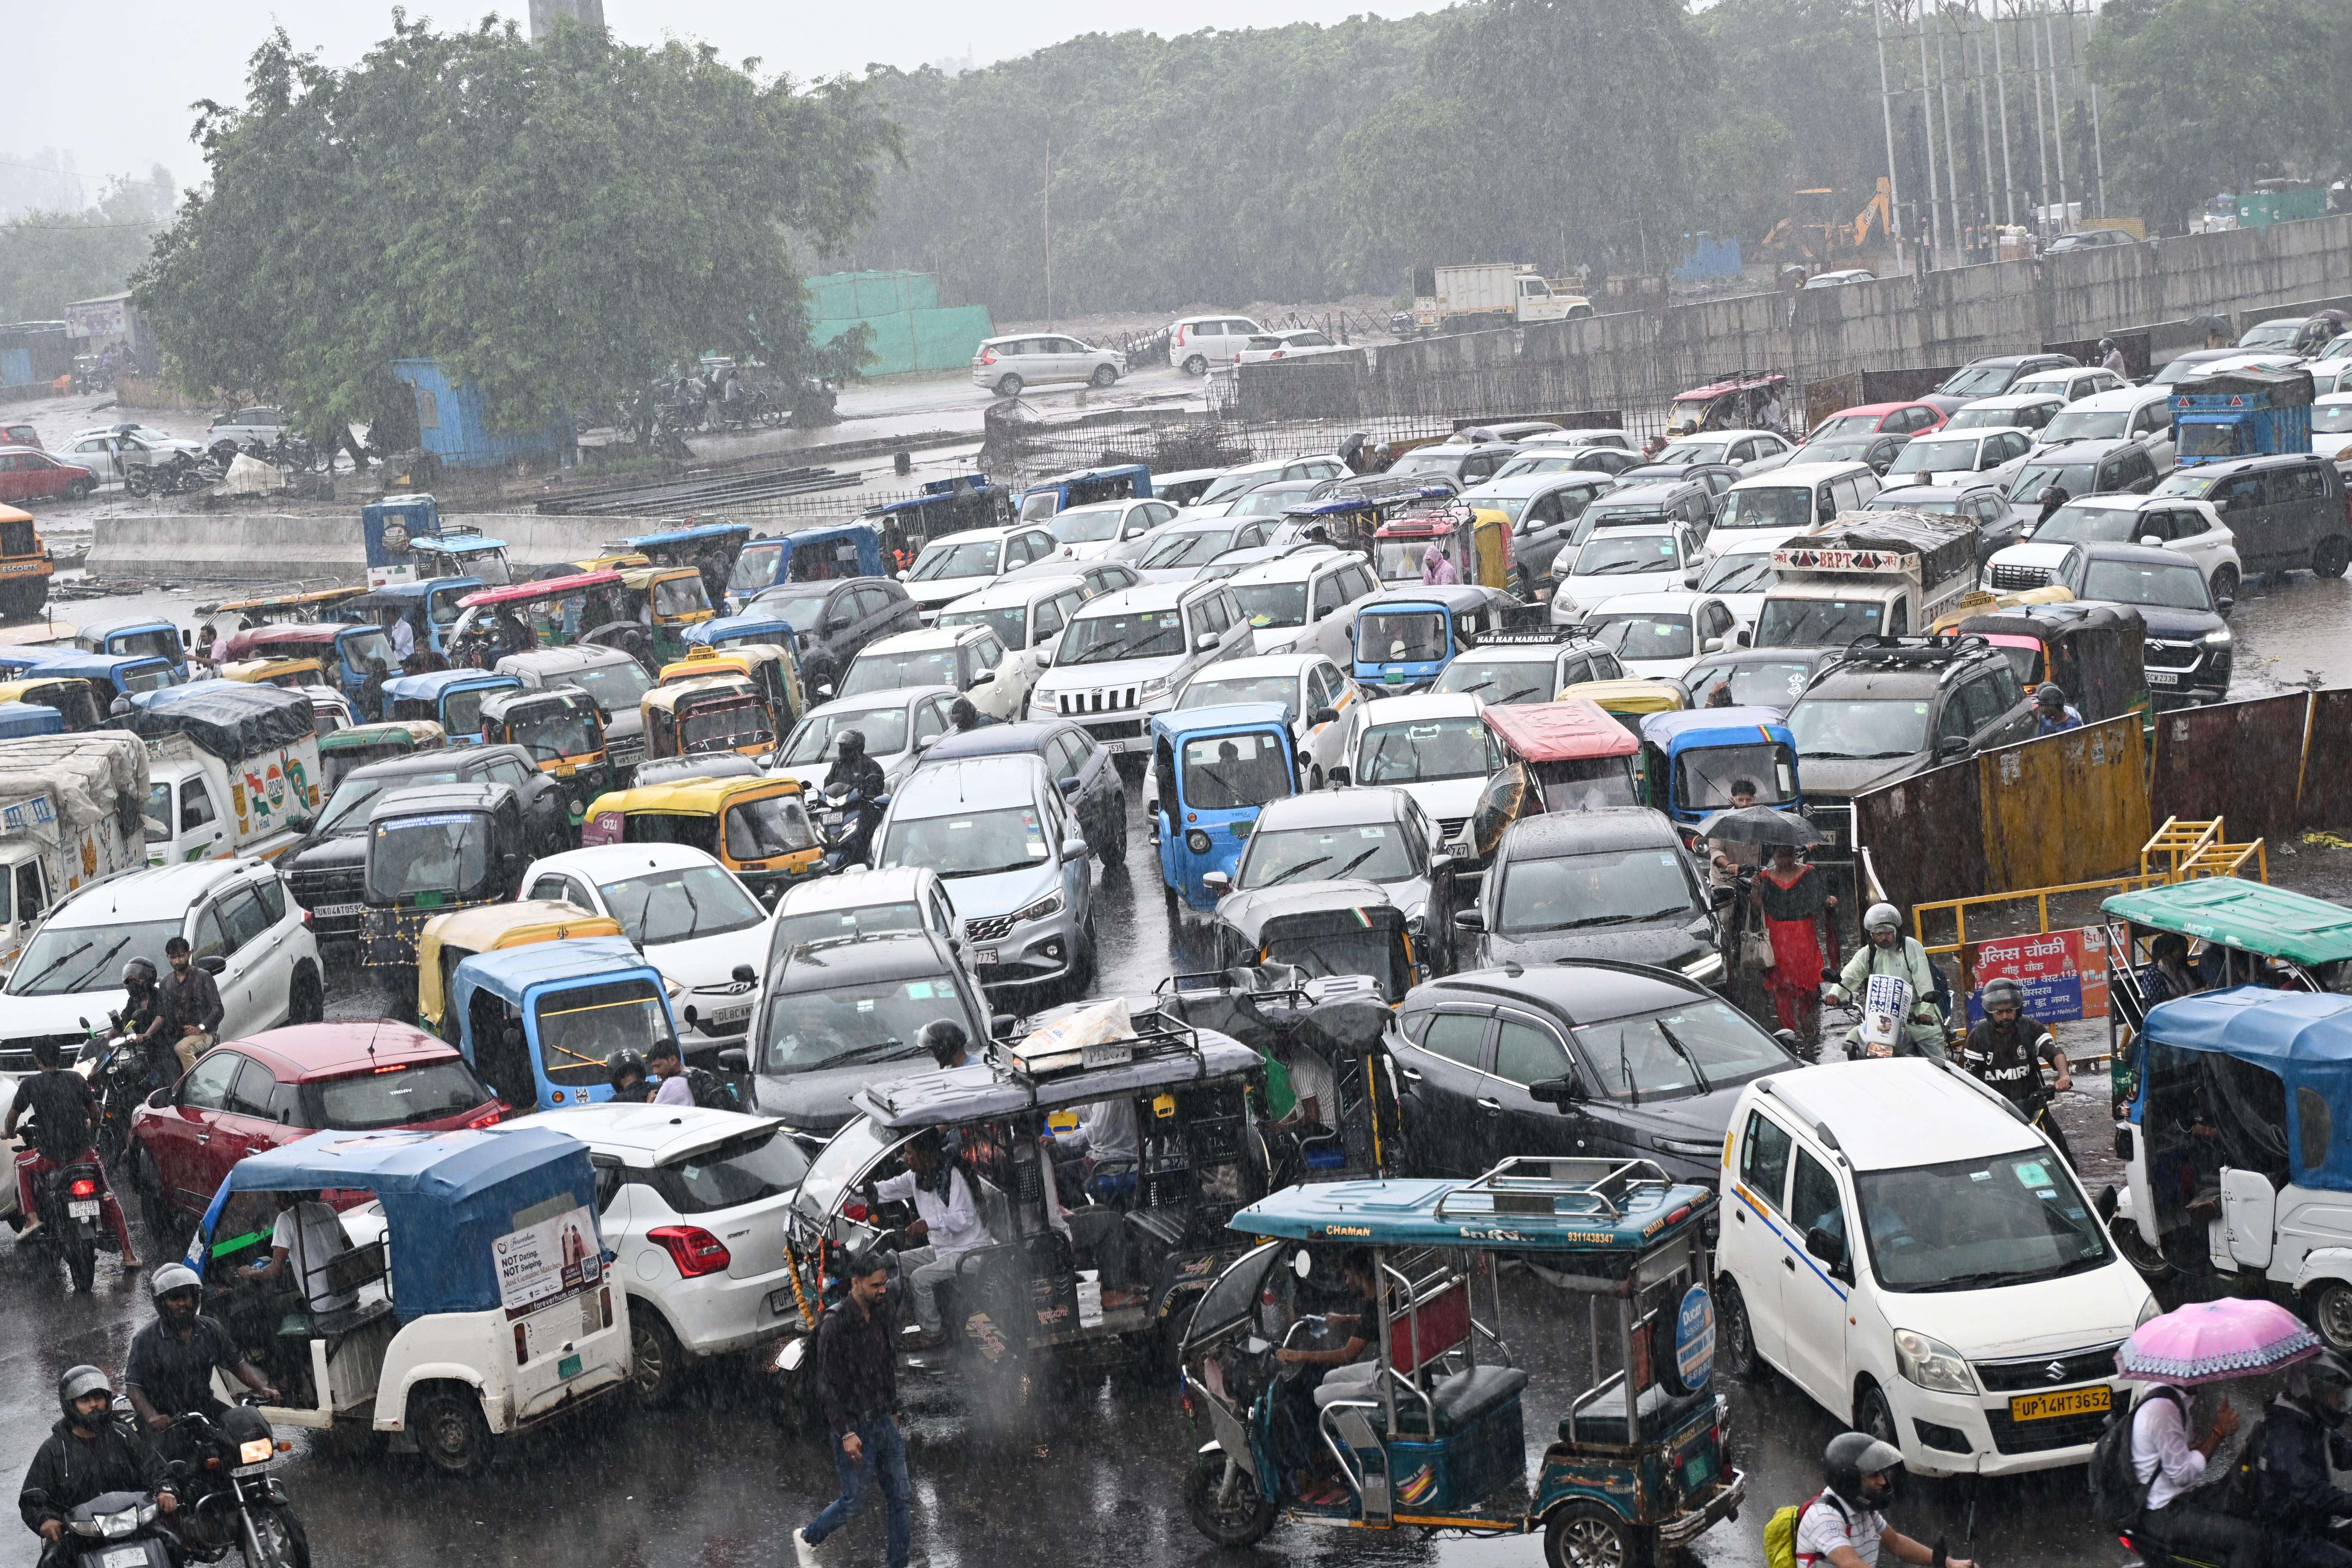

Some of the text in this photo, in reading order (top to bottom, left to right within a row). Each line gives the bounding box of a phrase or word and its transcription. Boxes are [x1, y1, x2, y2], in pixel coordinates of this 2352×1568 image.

[3, 564, 38, 574] ESCORTS
[1514, 634, 1557, 642] MAHADEV
[268, 778, 283, 798] 2024
[259, 816, 270, 830] Hind
[387, 817, 425, 827] CHAUDHARY
[2024, 936, 2066, 958] चौकी
[2024, 960, 2044, 972] चौक
[2061, 969, 2077, 978] 112
[2051, 995, 2071, 1004] नगर
[719, 1006, 753, 1021] DL8CAM
[1089, 1050, 1127, 1064] PILOT
[1985, 1064, 2030, 1081] AMIRI
[75, 1208, 96, 1216] H7627
[727, 1229, 751, 1240] SWIFT
[1643, 1217, 1665, 1238] CHAMAN
[1568, 1231, 1614, 1243] 9311438347
[501, 1250, 539, 1268] NOT Dating.
[503, 1259, 543, 1278] NOT Swiping.
[505, 1277, 517, 1288] Just
[517, 1270, 539, 1283] Genuine
[540, 1263, 563, 1274] Matches.
[534, 1287, 580, 1310] foreverhum.com
[1038, 1308, 1069, 1320] PILOT
